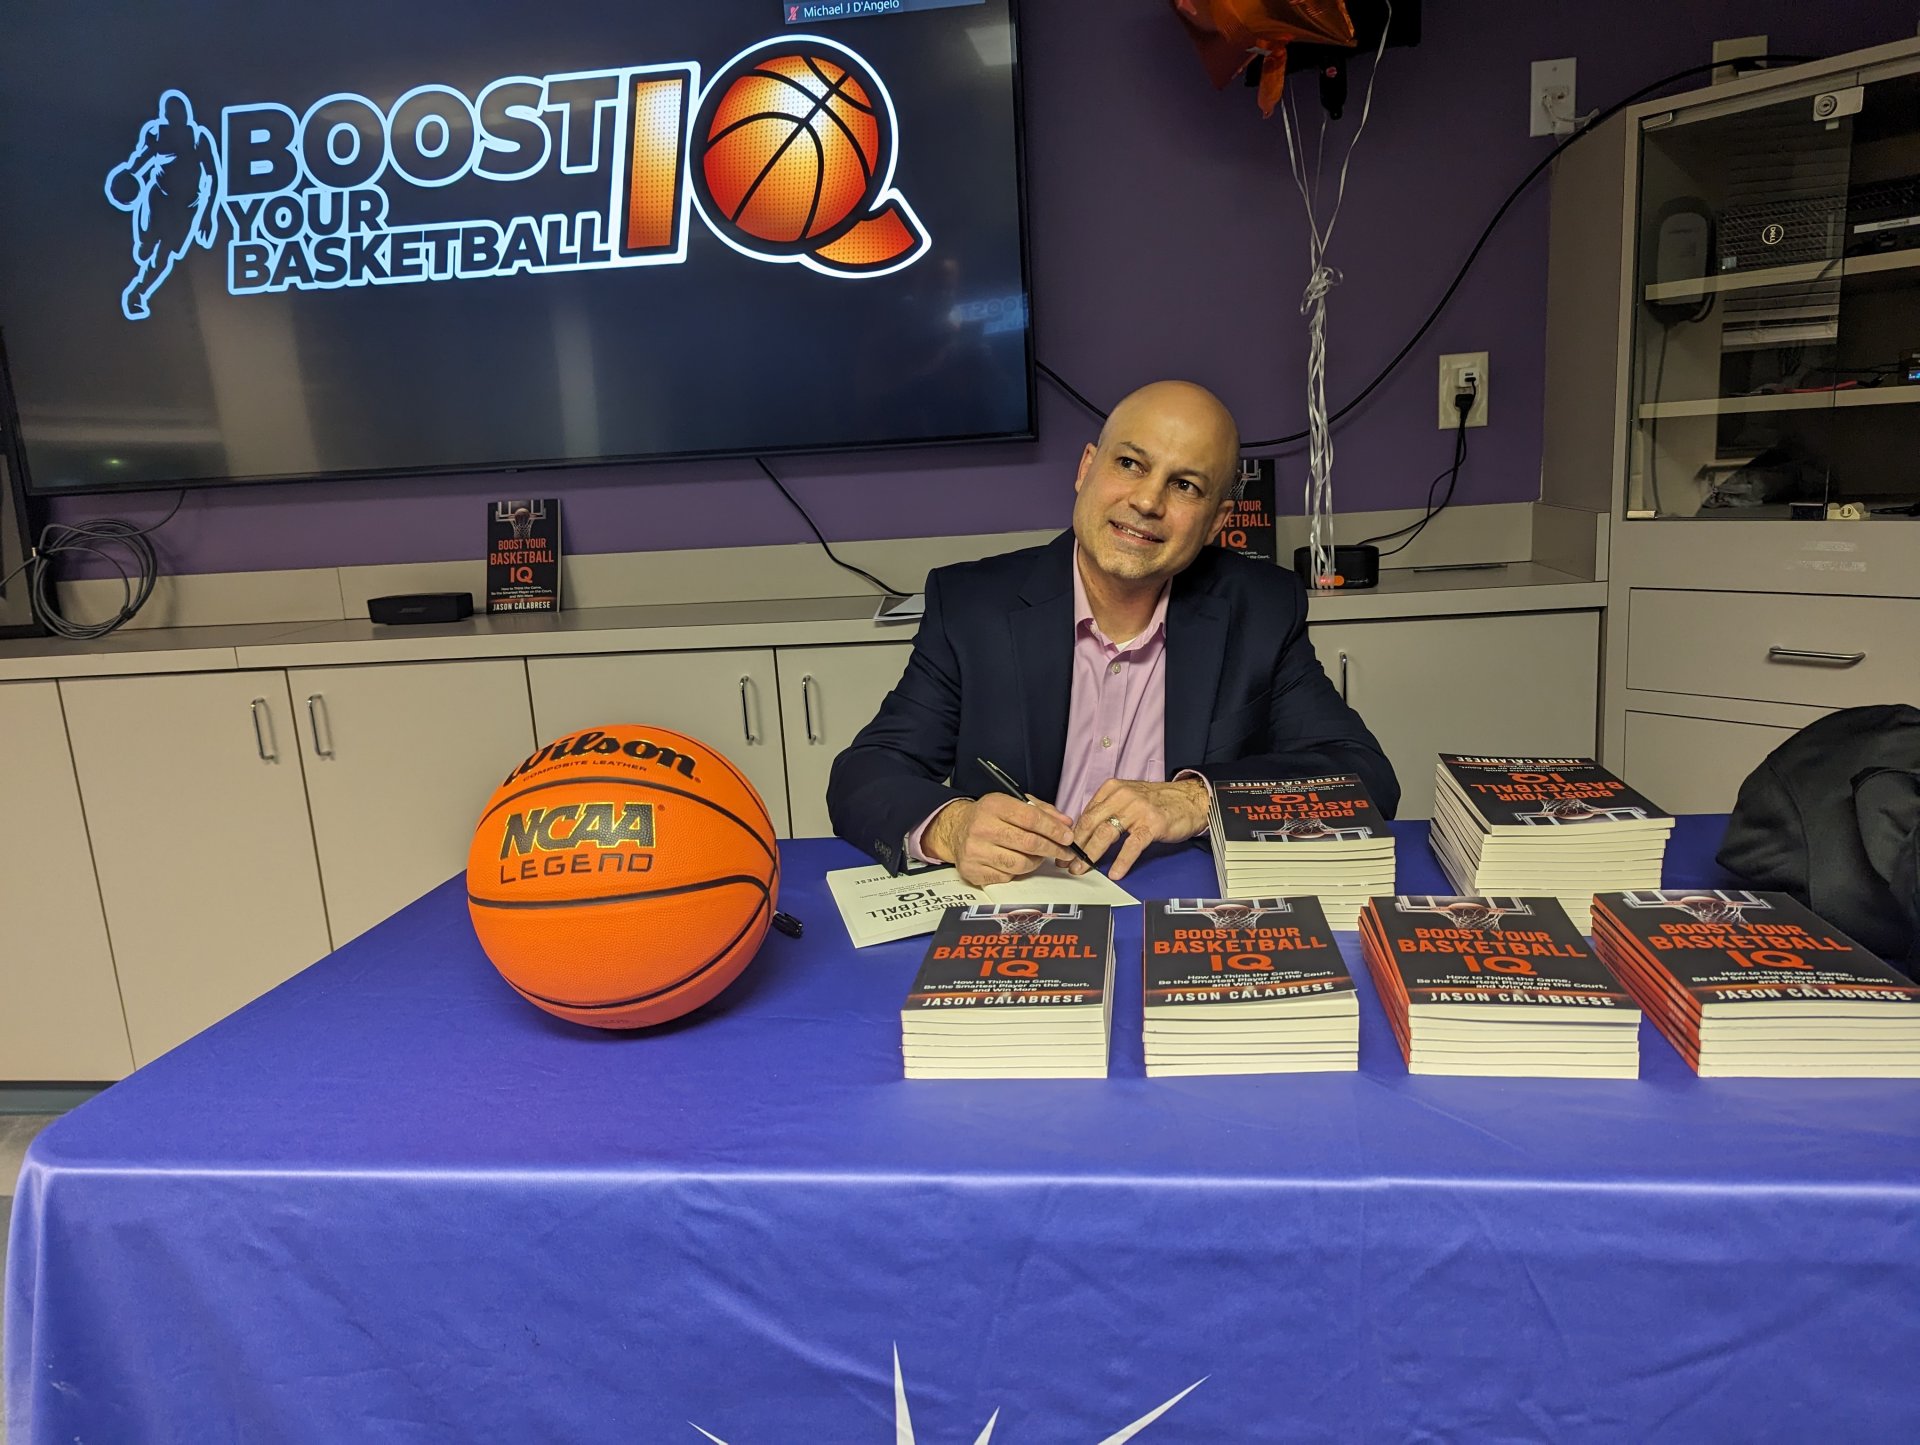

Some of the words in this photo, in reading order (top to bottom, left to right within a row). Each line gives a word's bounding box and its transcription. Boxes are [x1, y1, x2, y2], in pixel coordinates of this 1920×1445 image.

[803, 3, 844, 18] Michael
[846, 2, 851, 14] J
[853, 0, 900, 13] D'Angelo
[222, 68, 618, 198] BOOST
[618, 35, 932, 279] IQ
[224, 188, 390, 243] YOUR
[228, 212, 613, 295] BASKETBALL
[1237, 500, 1262, 511] YOUR
[498, 539, 523, 550] BOOST
[526, 538, 546, 549] YOUR
[1221, 530, 1247, 549] IQ
[490, 550, 554, 566] BASKETBALL
[510, 566, 533, 584] IQ
[493, 602, 512, 611] JASON
[514, 601, 550, 610] CALABRESE
[522, 760, 588, 782] COMPOSITE
[592, 759, 648, 772] LEATHER
[1507, 772, 1565, 784] IQ
[1470, 781, 1625, 793] BASKETBALL
[1553, 790, 1615, 800] BOOST
[1270, 792, 1319, 804] IQ
[1496, 793, 1549, 801] YOUR
[1228, 800, 1369, 814] BASKETBALL
[1299, 809, 1355, 819] BOOST
[1247, 812, 1293, 820] YOUR
[500, 801, 657, 860] NCAA
[500, 852, 655, 885] LEGEND
[896, 888, 936, 902] IQ
[866, 893, 977, 918] BASKETBALL
[885, 909, 920, 922] YOUR
[1174, 928, 1240, 940] BOOST
[1244, 927, 1301, 939] YOUR
[1414, 927, 1483, 941] BOOST
[1490, 928, 1553, 943] YOUR
[1659, 923, 1734, 935] BOOST
[1741, 924, 1809, 936] YOUR
[958, 934, 1021, 945] BOOST
[1028, 934, 1078, 945] YOUR
[1154, 936, 1328, 954] BASKETBALL
[1648, 935, 1853, 951] BASKETBALL
[932, 946, 1098, 960] BASKETBALL
[1397, 939, 1587, 957] BASKETBALL
[1210, 953, 1275, 972] IQ
[1463, 955, 1538, 975] IQ
[1726, 950, 1814, 969] IQ
[979, 959, 1040, 978] IQ
[1164, 991, 1220, 1002] JASON
[1229, 982, 1334, 1000] CALABRESE
[1430, 992, 1491, 1002] JASON
[1498, 993, 1615, 1006] CALABRESE
[1715, 988, 1782, 1000] JASON
[1786, 988, 1912, 1001] CALABRESE
[922, 996, 976, 1006] JASON
[983, 995, 1083, 1004] CALABRESE
